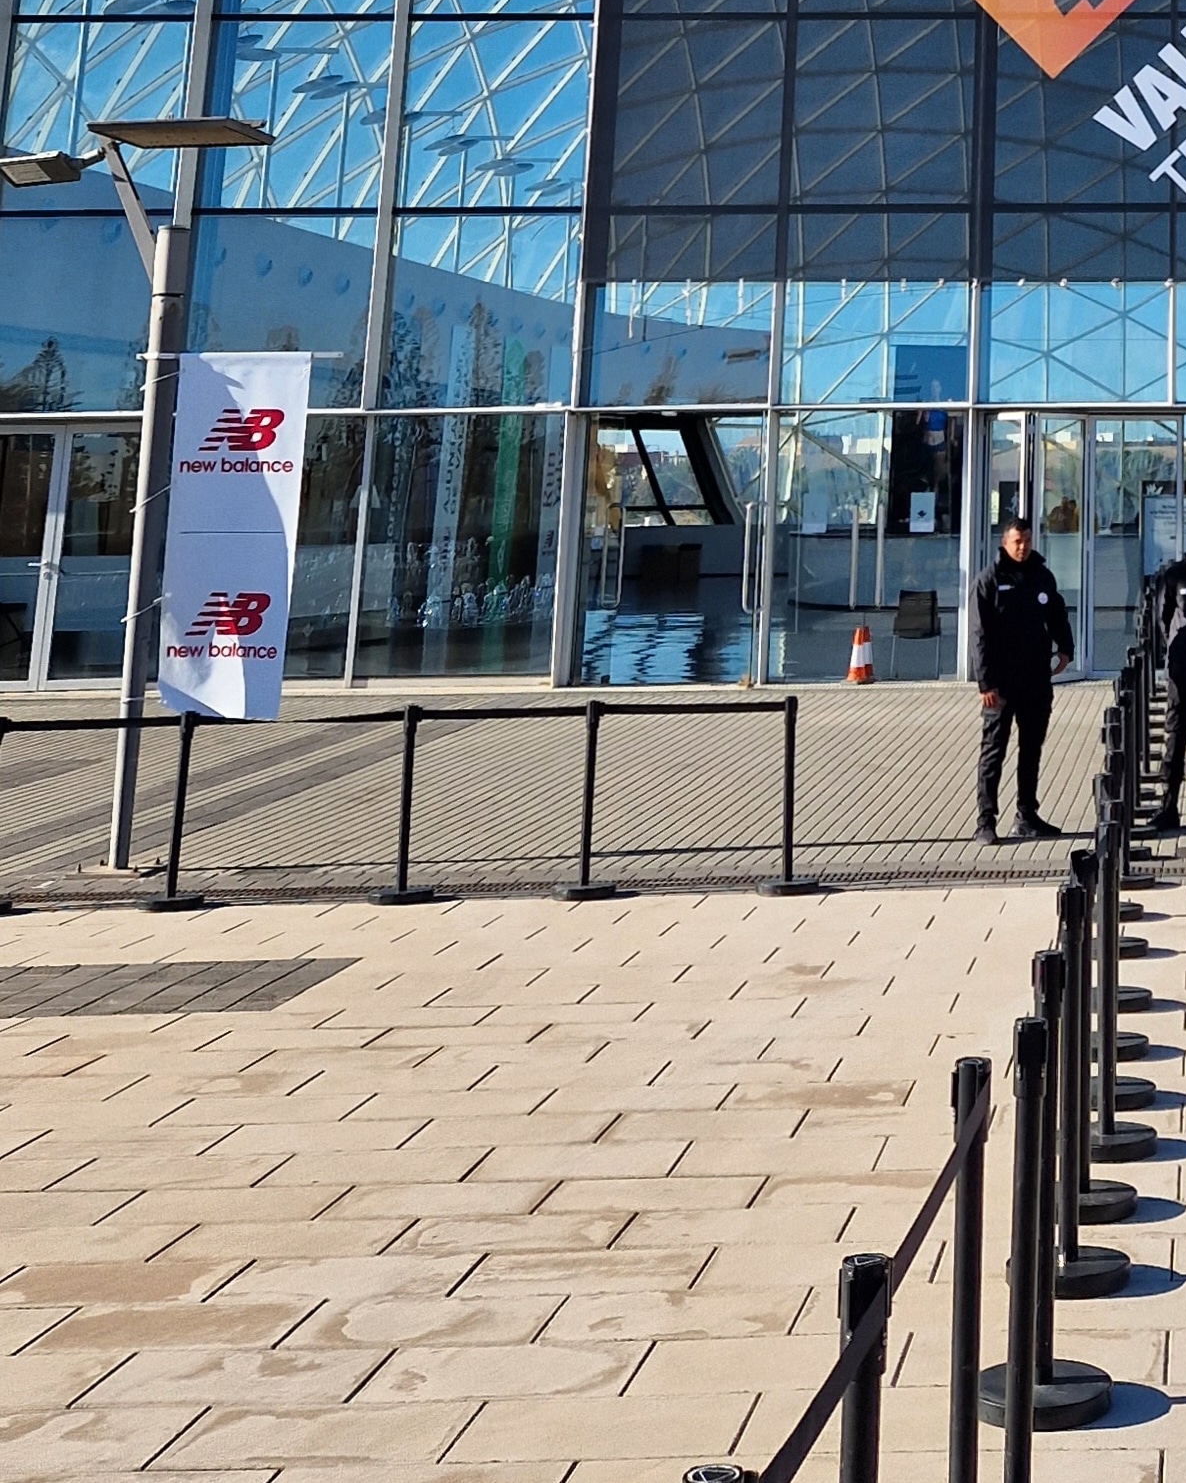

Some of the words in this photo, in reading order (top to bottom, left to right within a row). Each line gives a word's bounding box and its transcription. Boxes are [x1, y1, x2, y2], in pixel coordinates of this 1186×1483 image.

[179, 459, 216, 473] new
[221, 457, 294, 473] balance
[166, 645, 203, 659] new
[208, 643, 278, 660] balance
